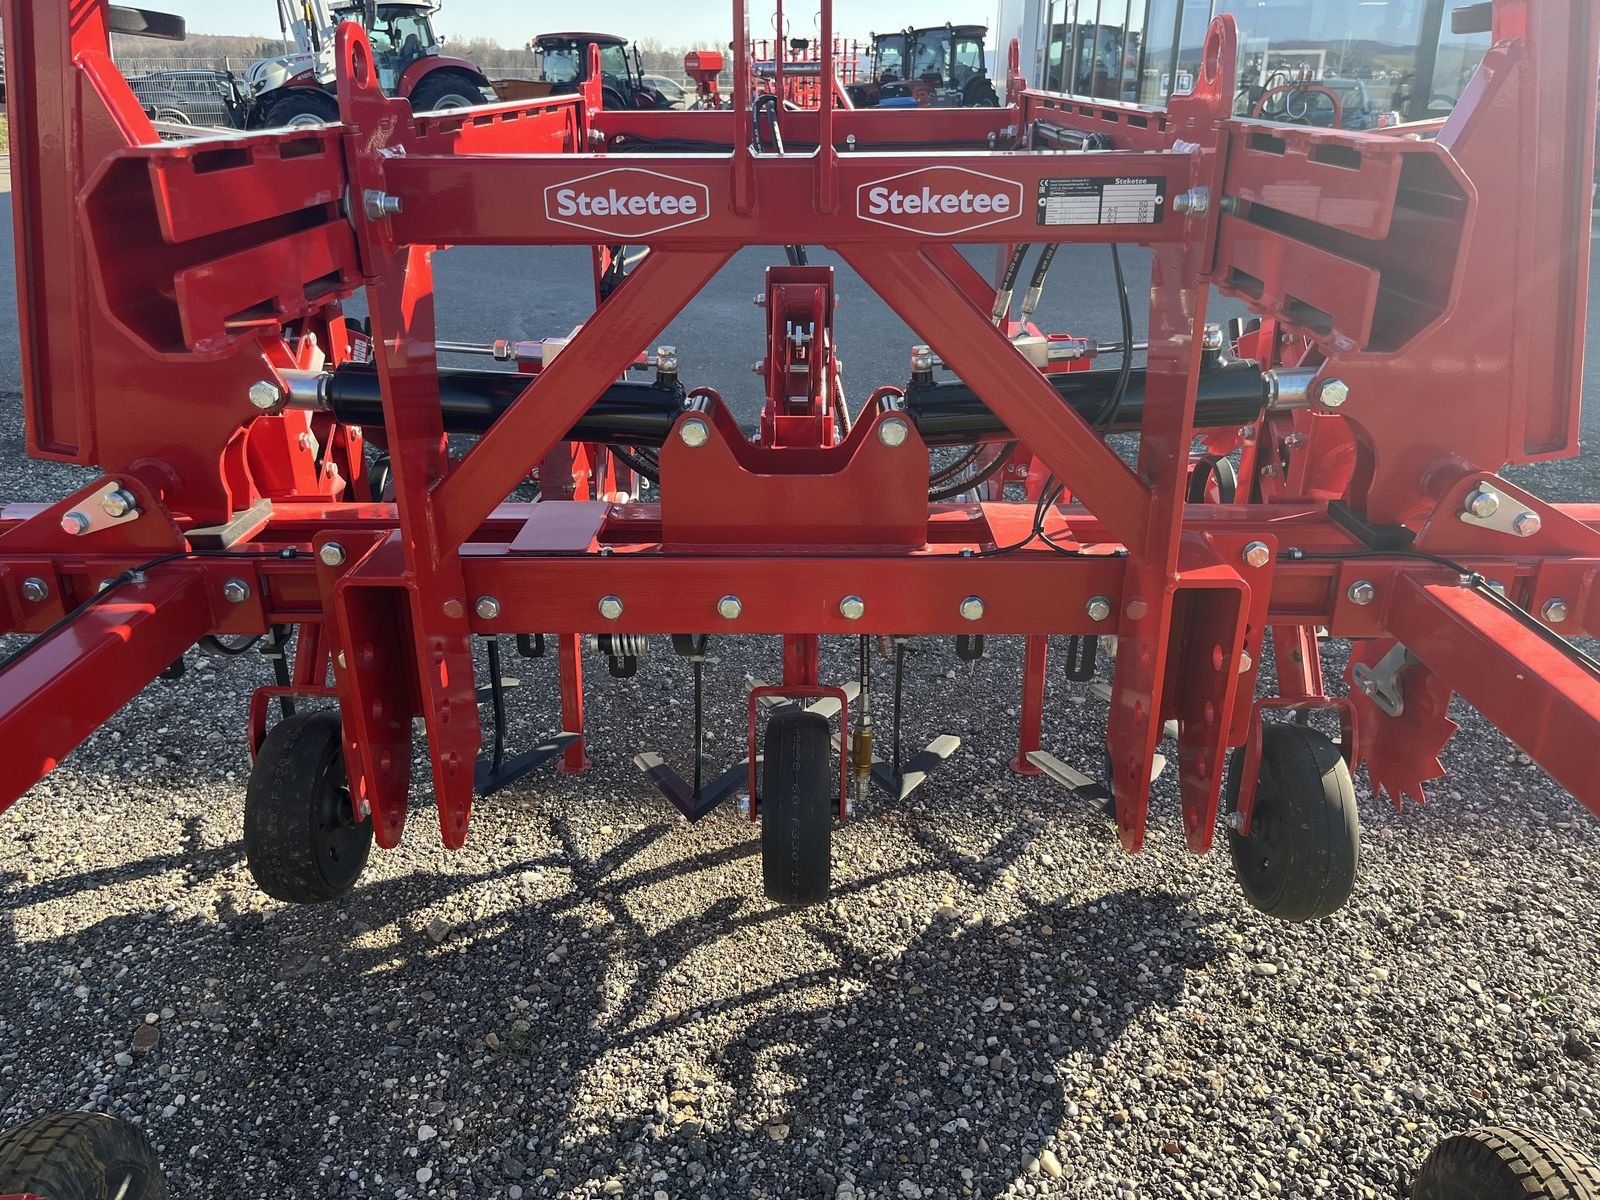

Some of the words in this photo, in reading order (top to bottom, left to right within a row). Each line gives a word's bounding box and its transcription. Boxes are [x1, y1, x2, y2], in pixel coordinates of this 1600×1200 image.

[1115, 177, 1148, 185] Steketee
[557, 189, 697, 216] Steketee
[869, 187, 1010, 214] Steketee
[792, 817, 800, 861] F330
